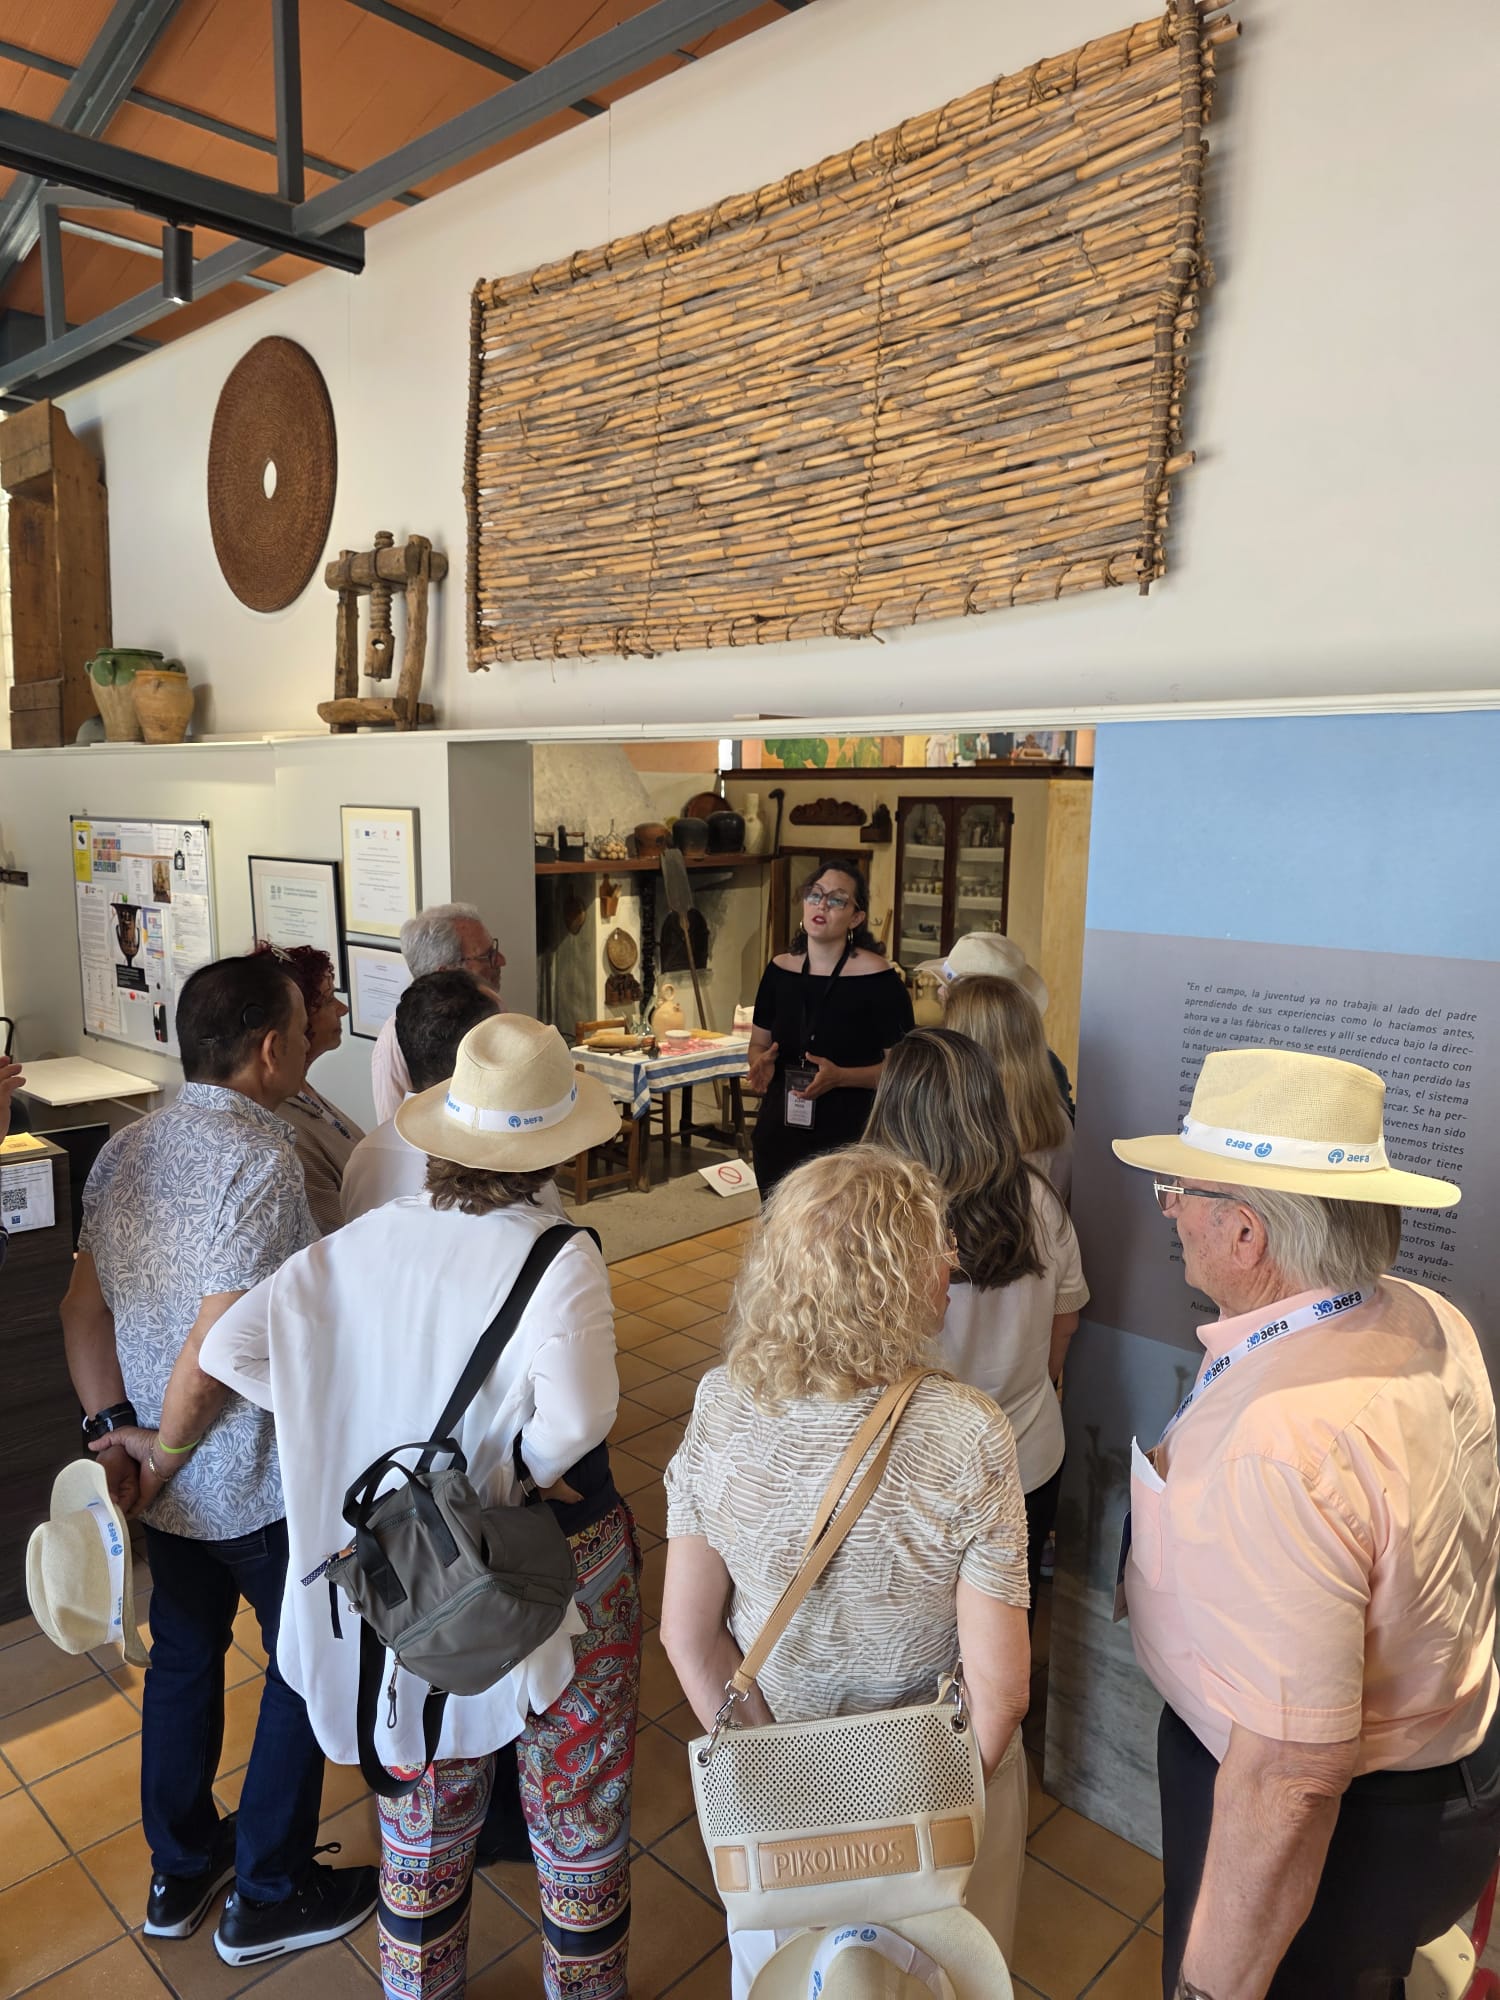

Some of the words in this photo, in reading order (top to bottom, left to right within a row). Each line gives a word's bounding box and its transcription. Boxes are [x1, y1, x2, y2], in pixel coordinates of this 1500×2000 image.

[1216, 987, 1247, 998] campo,
[1251, 989, 1260, 998] la
[1263, 990, 1306, 1003] juventud
[1309, 997, 1321, 1005] ya
[1325, 998, 1338, 1007] no
[1382, 1004, 1393, 1013] al
[1398, 1005, 1420, 1016] lado
[1425, 1008, 1442, 1018] del
[1446, 1011, 1478, 1022] padre
[1184, 998, 1237, 1010] aprendiendo
[1242, 1003, 1253, 1013] de
[1258, 1006, 1273, 1015] sus
[1277, 1008, 1336, 1022] experiencias
[1340, 1015, 1368, 1026] como
[1373, 1018, 1383, 1028] lo
[1442, 1028, 1475, 1040] antes,
[1184, 1012, 1208, 1022] ahora
[1210, 1015, 1220, 1024] va
[1230, 1017, 1243, 1026] las
[1245, 1018, 1281, 1032] fábricas
[1292, 1025, 1327, 1037] talleres
[1329, 1031, 1337, 1040] y
[1356, 1034, 1368, 1042] se
[1370, 1034, 1400, 1046] educa
[1403, 1038, 1426, 1051] bajo
[1428, 1041, 1439, 1051] la
[1183, 1026, 1201, 1036] ción
[1203, 1028, 1214, 1038] de
[1216, 1030, 1227, 1039] un
[1229, 1032, 1266, 1045] capataz.
[1268, 1036, 1284, 1046] Por
[1286, 1039, 1302, 1049] eso
[1304, 1042, 1314, 1051] se
[1317, 1042, 1337, 1054] está
[1339, 1046, 1389, 1061] perdiendo
[1391, 1053, 1401, 1062] el
[1403, 1055, 1450, 1069] contacto
[1452, 1062, 1473, 1072] con
[1182, 1040, 1190, 1049] la
[1391, 1070, 1410, 1080] han
[1412, 1074, 1453, 1087] perdido
[1455, 1079, 1471, 1089] las
[1415, 1090, 1426, 1099] el
[1429, 1092, 1469, 1106] sistema
[1412, 1105, 1426, 1116] Se
[1429, 1108, 1442, 1118] ha
[1384, 1117, 1420, 1131] óvenes
[1422, 1123, 1441, 1135] han
[1444, 1127, 1466, 1139] sido
[1431, 1141, 1465, 1155] tristes
[1389, 1150, 1433, 1166] labrador
[1436, 1159, 1463, 1172] tiene
[1445, 1209, 1459, 1220] da
[1441, 1241, 1457, 1252] las
[773, 1839, 905, 1880] PIKOLINOS
